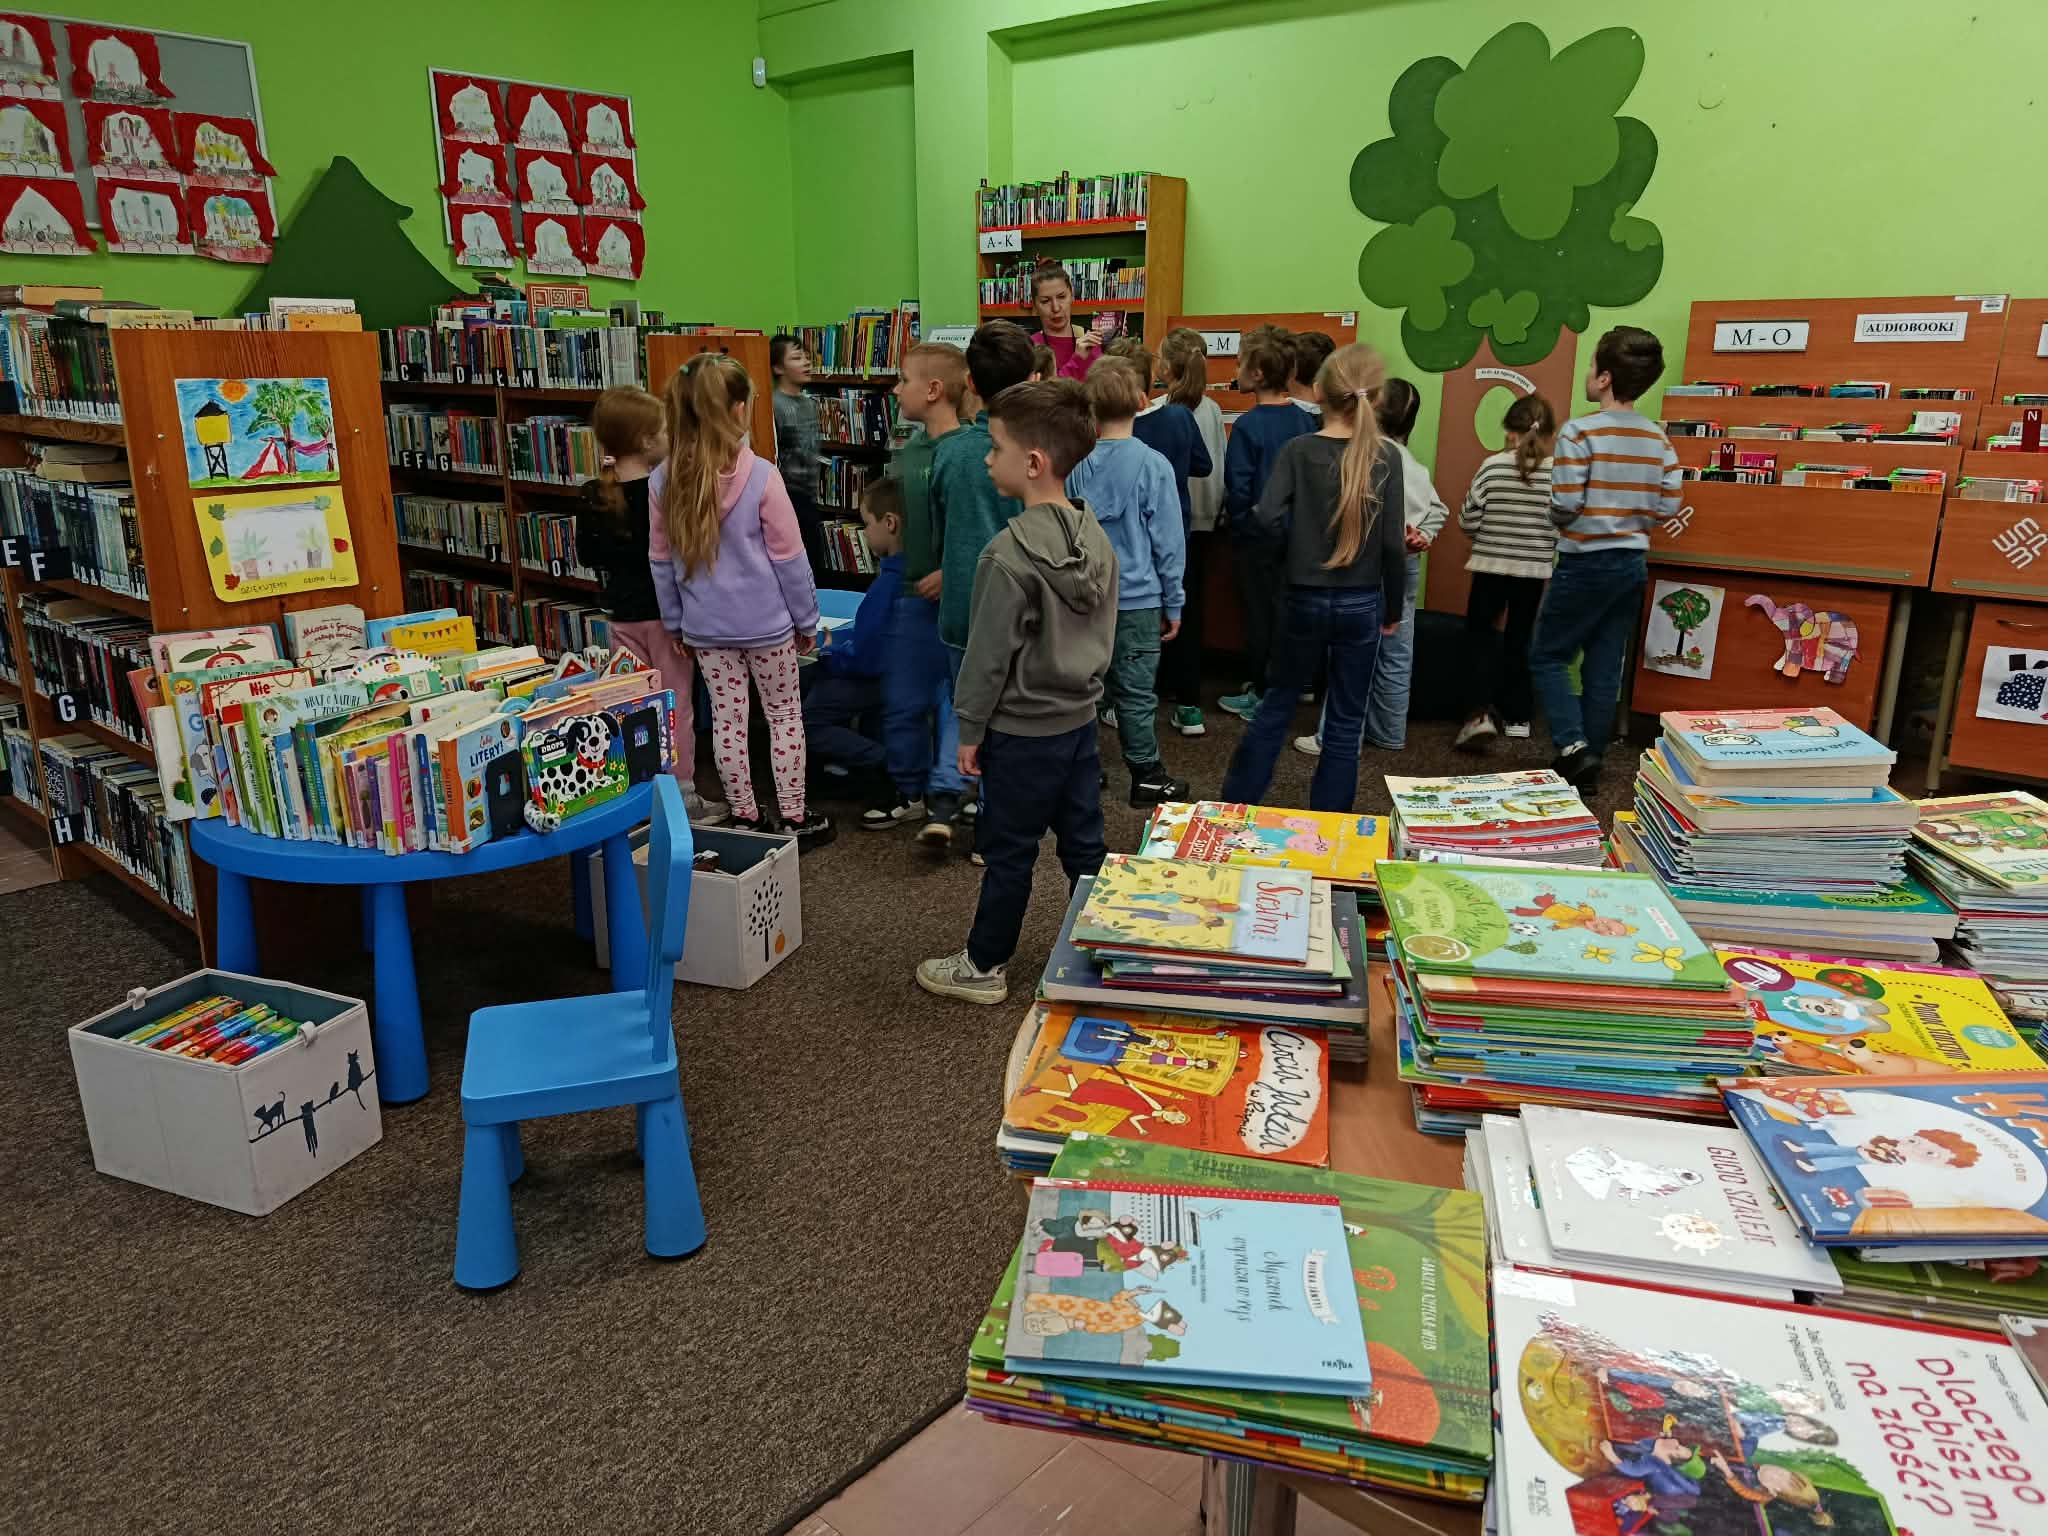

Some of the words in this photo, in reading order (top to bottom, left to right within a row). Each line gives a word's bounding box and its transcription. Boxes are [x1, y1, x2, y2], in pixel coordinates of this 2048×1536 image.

[986, 236, 995, 249] A
[1005, 234, 1014, 247] K
[1865, 320, 1955, 335] AUDIOBOOKI
[1215, 336, 1231, 351] M
[1731, 328, 1753, 346] M
[1771, 328, 1792, 346] O
[400, 364, 409, 381] C
[456, 366, 465, 383] D
[522, 369, 535, 388] M
[2027, 411, 2039, 422] N
[1721, 444, 1734, 455] M
[403, 452, 411, 467] E
[415, 453, 424, 469] F
[440, 455, 449, 471] G
[2, 539, 21, 567] E
[445, 537, 455, 554] H
[489, 545, 497, 563] J
[30, 552, 46, 582] F
[551, 560, 562, 577] O
[58, 694, 77, 722] G
[469, 741, 504, 768] LITERY!
[541, 741, 565, 754] DROPS
[54, 816, 73, 844] H
[1253, 881, 1305, 936] Siostra
[1266, 1030, 1310, 1085] Ciocia
[1250, 1089, 1260, 1098] w
[1233, 1099, 1266, 1137] Rzymie
[1254, 1080, 1311, 1149] Jadzia
[1706, 1146, 1749, 1184] GUCIO
[1845, 1361, 1889, 1398] na
[1871, 1406, 1954, 1517] złość?
[1915, 1358, 2047, 1505] Dlaczego
[1898, 1385, 1982, 1481] robisz
[1959, 1490, 2020, 1536] mi
